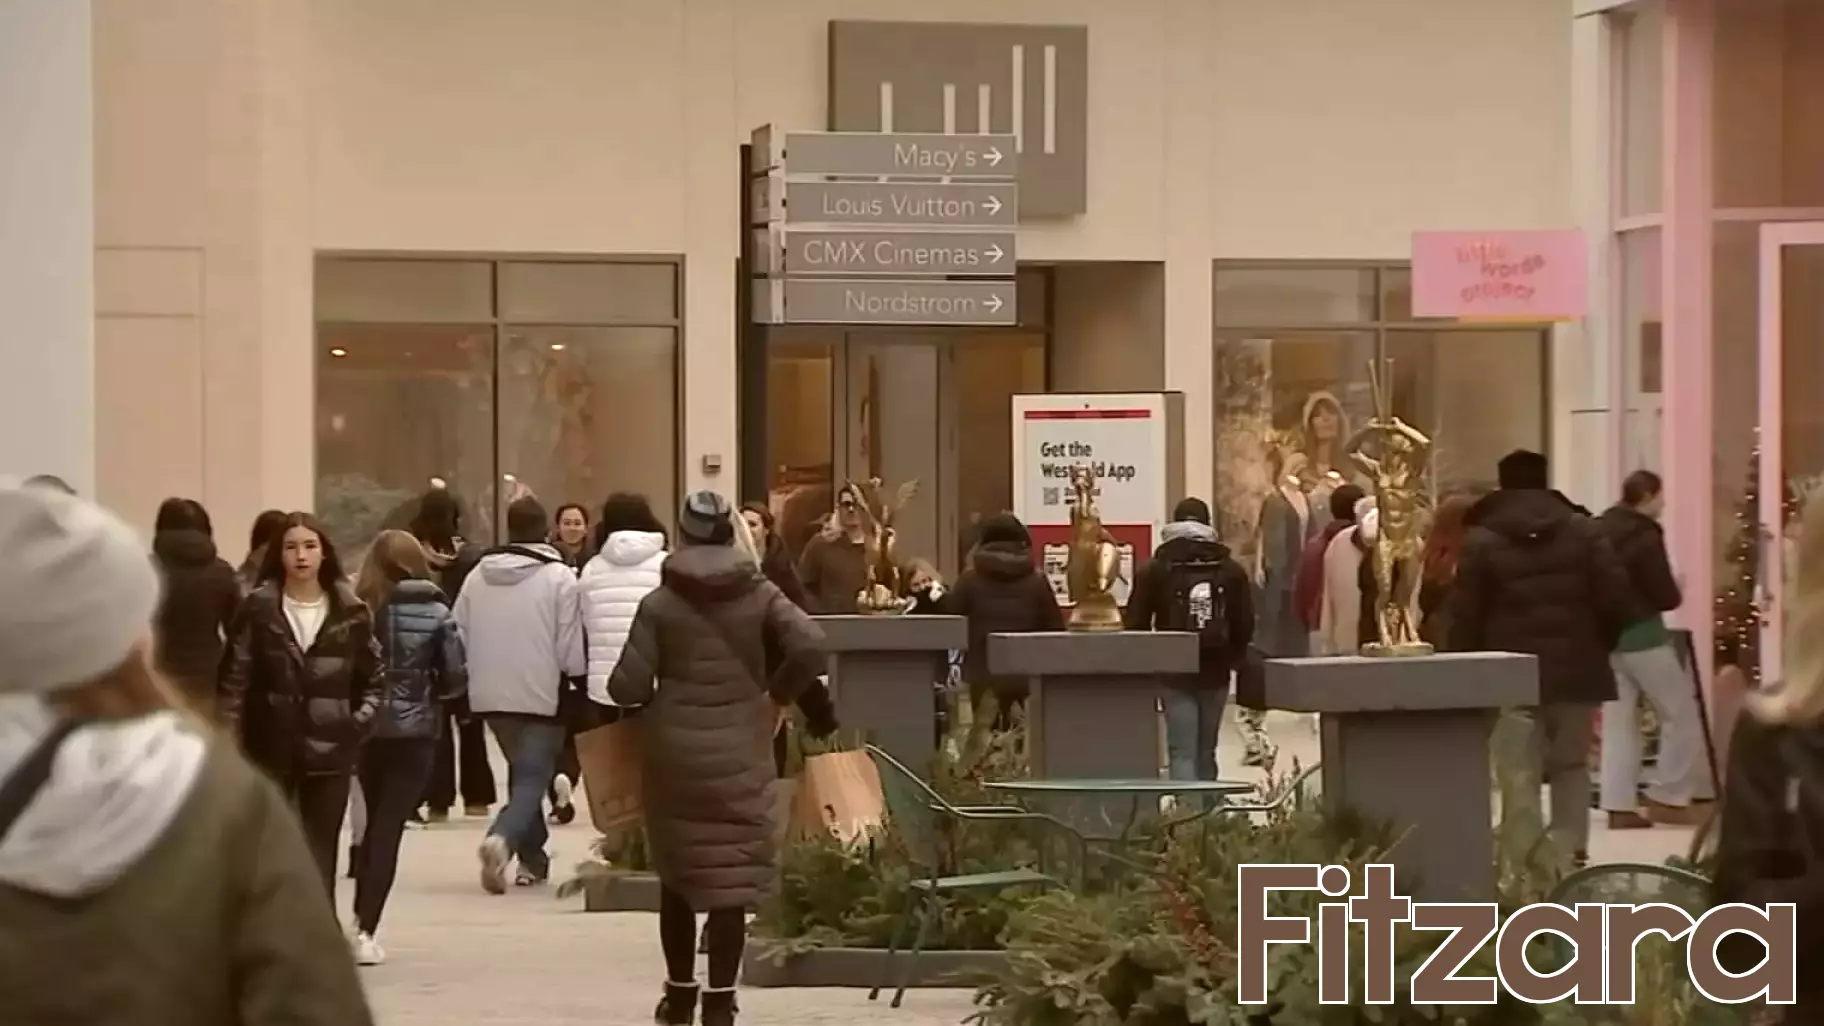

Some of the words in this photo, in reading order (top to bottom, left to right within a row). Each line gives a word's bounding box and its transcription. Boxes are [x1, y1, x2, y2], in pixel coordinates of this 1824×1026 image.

[894, 143, 977, 172] Macy's
[822, 194, 882, 216] Louis
[891, 194, 976, 217] Vuitton
[803, 241, 866, 264] CMX
[874, 241, 979, 265] Cinemas
[845, 290, 976, 314] Nordstrom
[1041, 442, 1066, 457] Get
[1068, 441, 1092, 457] the
[1041, 461, 1105, 478] Wesld
[1108, 462, 1135, 482] App
